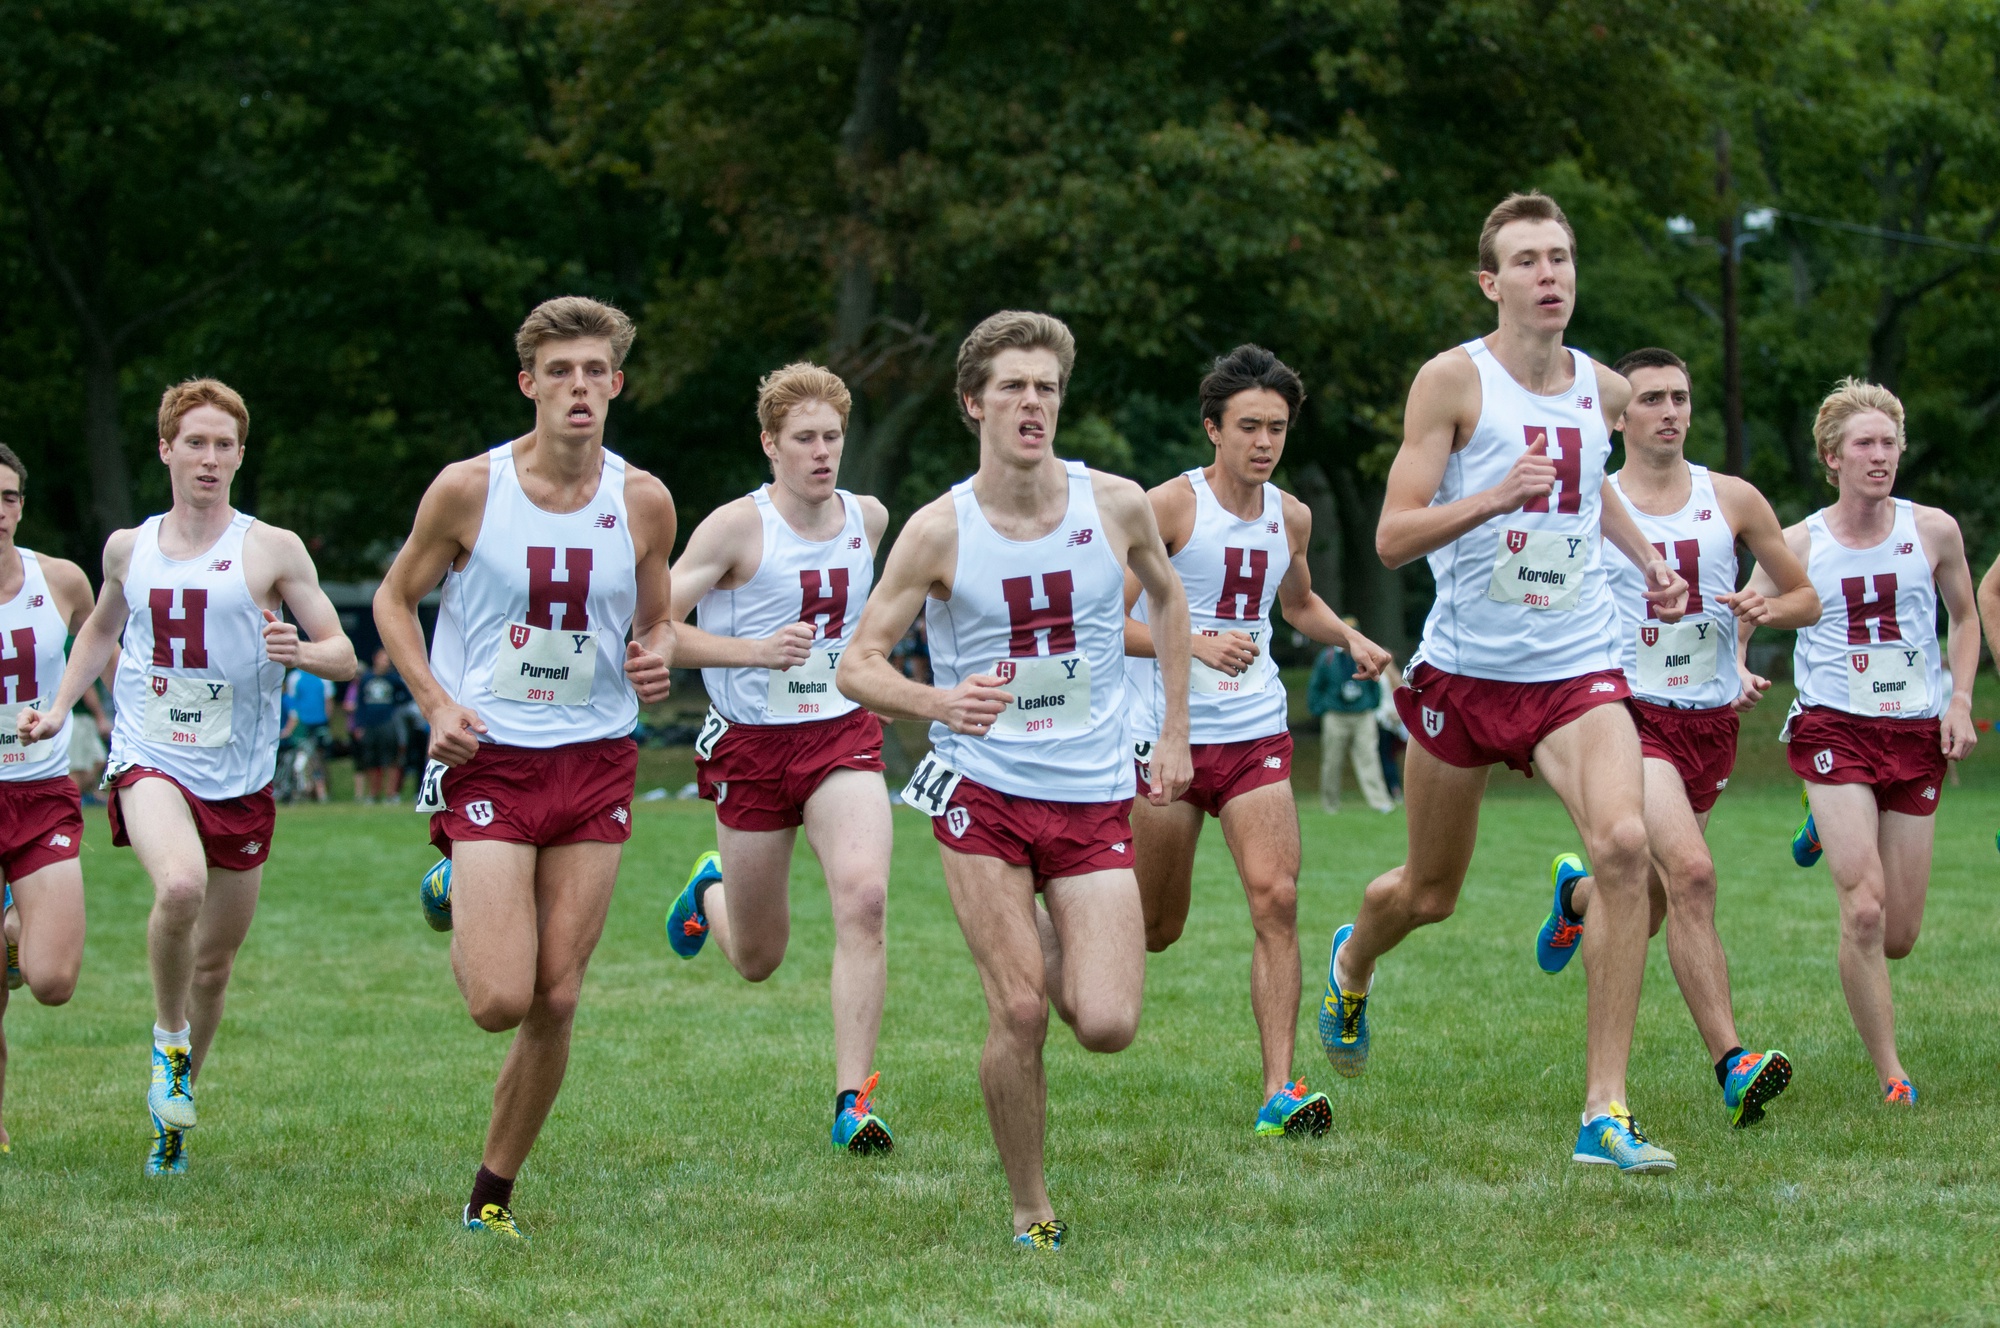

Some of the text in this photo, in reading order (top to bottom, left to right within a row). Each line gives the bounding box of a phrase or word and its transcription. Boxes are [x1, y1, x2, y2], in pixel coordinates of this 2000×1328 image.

[1522, 426, 1582, 515] H
[1510, 532, 1523, 549] H
[1567, 538, 1581, 558] Y
[1215, 547, 1268, 620] H
[1518, 565, 1566, 585] Korolev
[1646, 538, 1703, 619] H
[525, 546, 593, 631] H
[800, 568, 849, 640] H
[1523, 593, 1550, 607] 2013
[1002, 570, 1077, 658] H
[1841, 573, 1902, 645] H
[149, 588, 208, 669] H
[513, 627, 527, 644] H
[1645, 629, 1655, 641] H
[1696, 623, 1710, 640] Y
[572, 635, 590, 653] Y
[0, 627, 39, 704] H
[827, 653, 840, 669] Y
[1665, 654, 1690, 668] Allen
[1855, 656, 1866, 668] H
[1904, 651, 1918, 667] Y
[520, 662, 569, 681] Purnell
[1061, 658, 1080, 679] Y
[156, 678, 165, 691] H
[788, 681, 827, 694] Meehan
[1218, 681, 1239, 691] 2013
[1667, 675, 1689, 687] 2013
[1873, 680, 1906, 693] Gemar
[207, 683, 224, 700] Y
[527, 688, 555, 701] 2013
[798, 703, 819, 714] 2013
[1018, 693, 1065, 711] Leakos
[1879, 701, 1901, 712] 2013
[169, 708, 202, 723] Ward
[1426, 709, 1440, 731] H
[1026, 718, 1053, 732] 2013
[172, 731, 197, 743] 2013
[3, 752, 26, 763] 2013
[1818, 752, 1829, 770] H
[906, 760, 954, 812] 44
[471, 803, 490, 820] H
[950, 810, 964, 831] H
